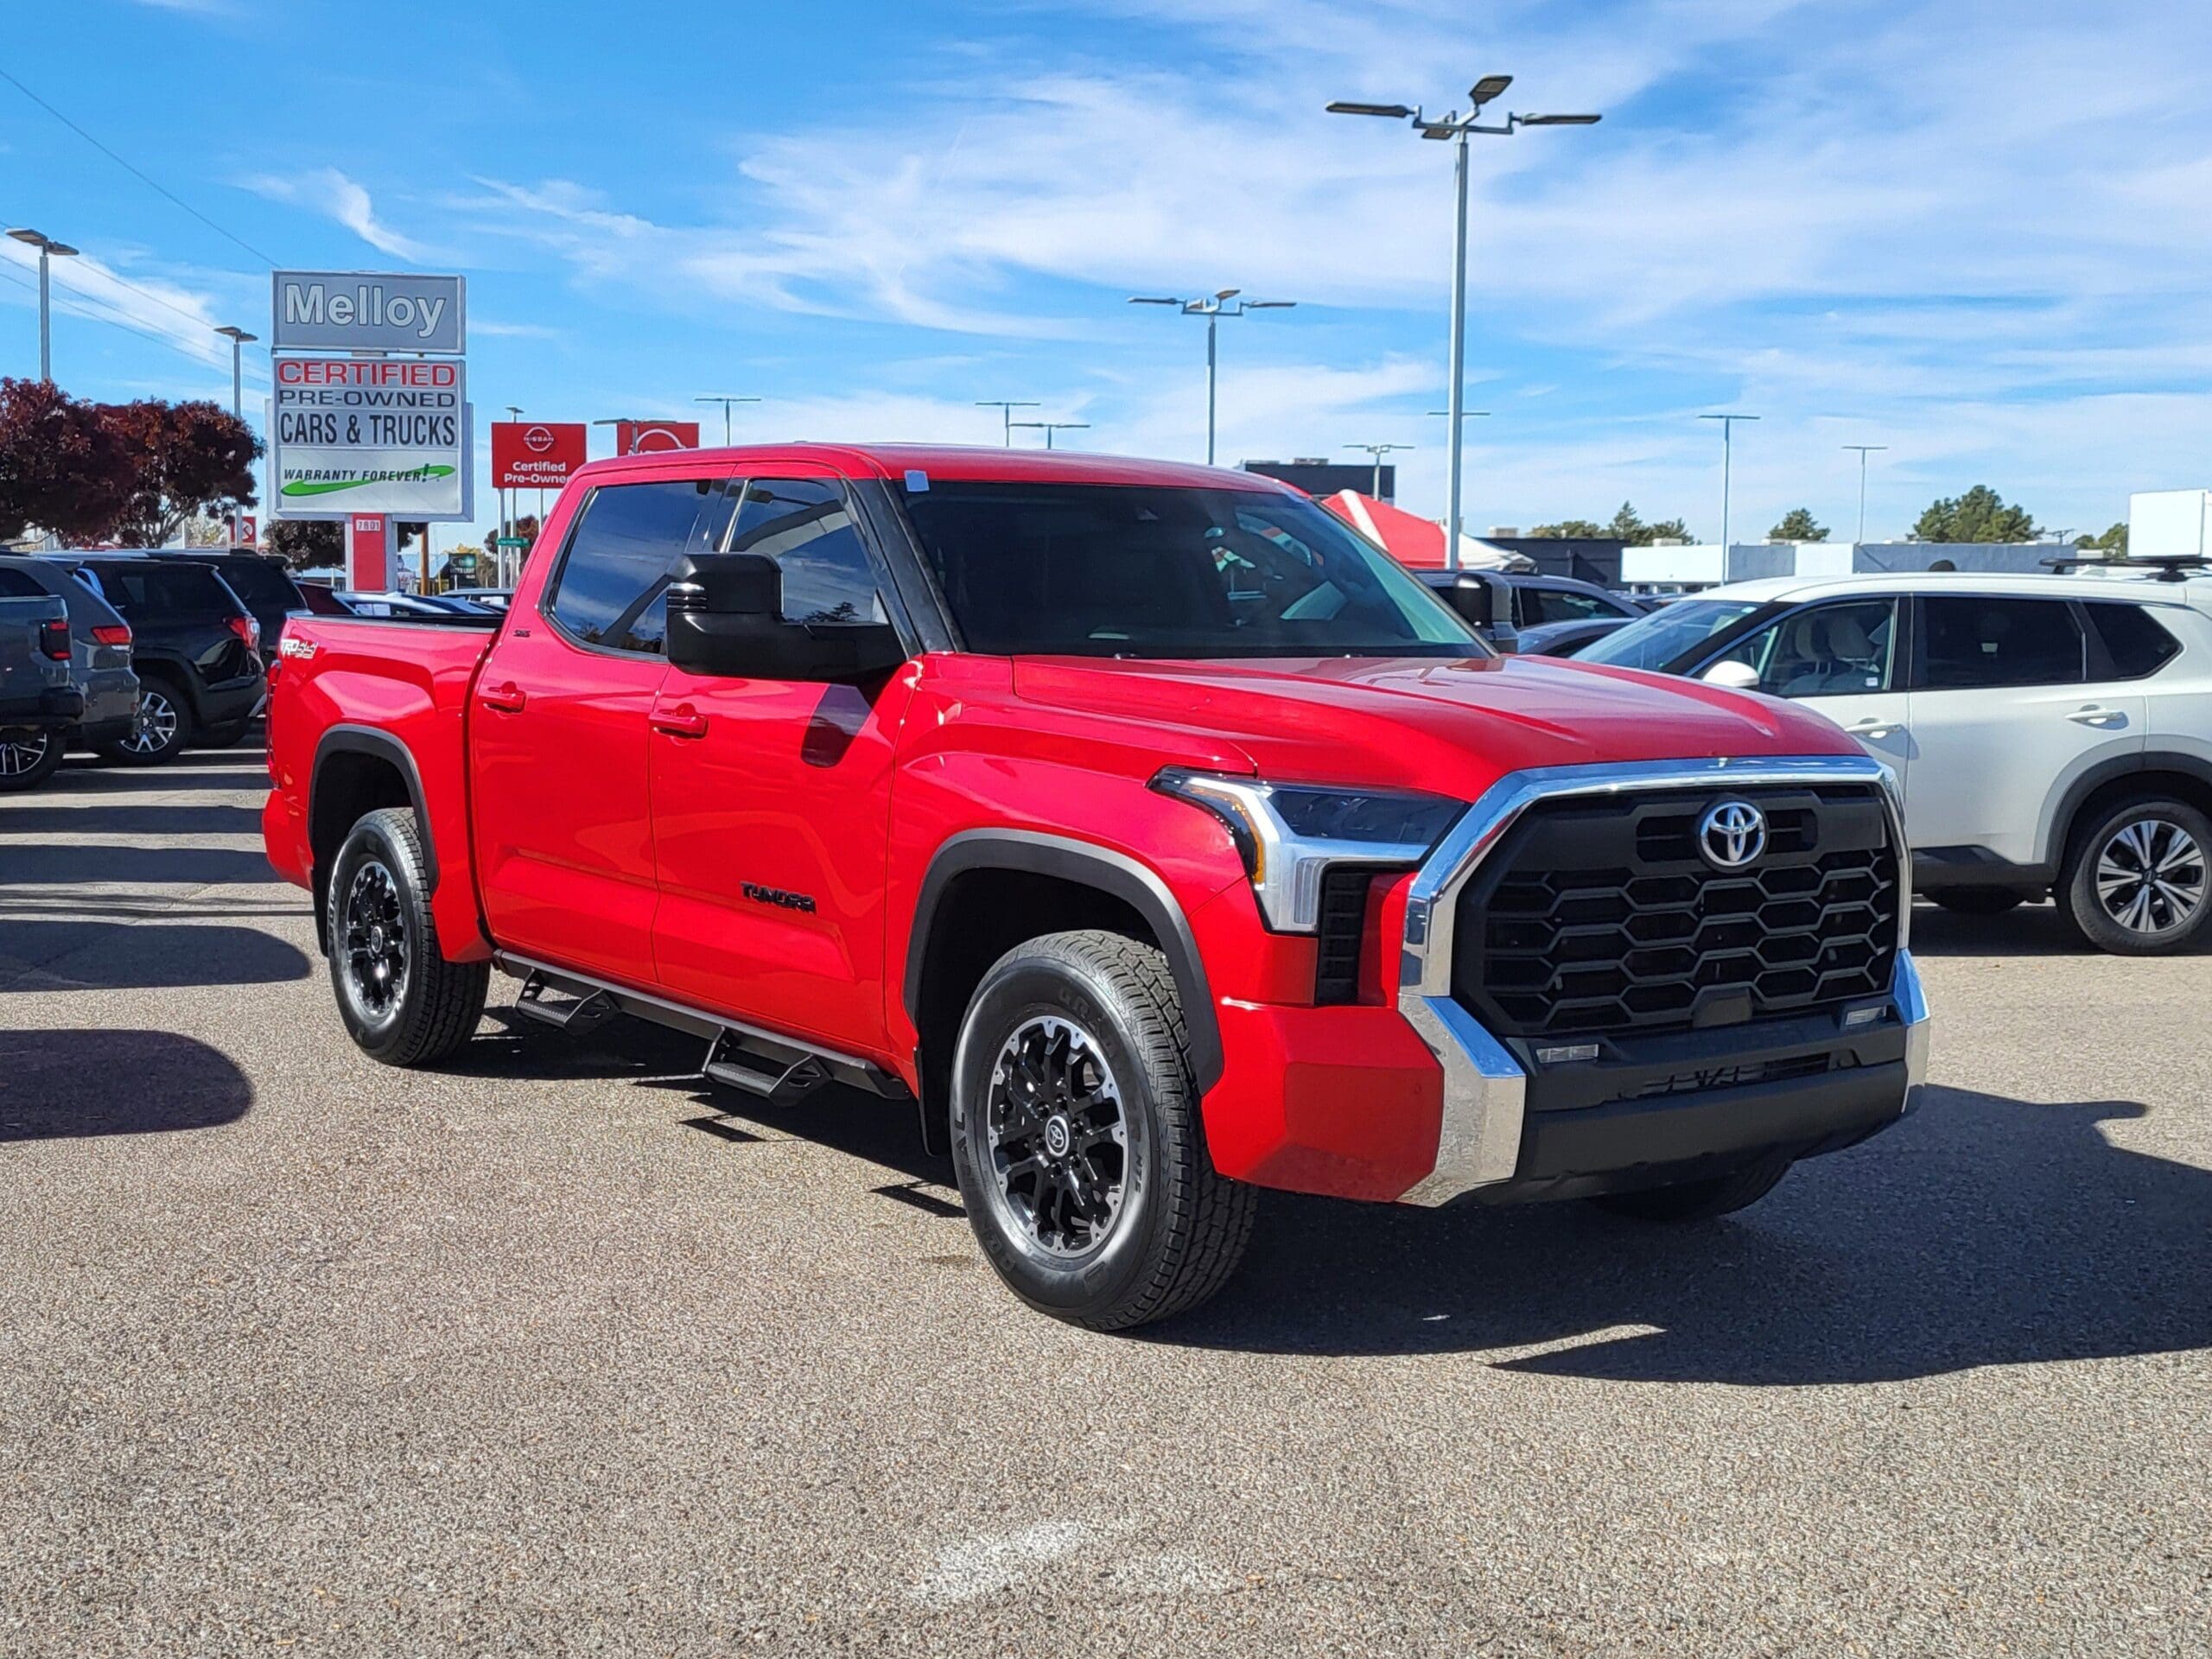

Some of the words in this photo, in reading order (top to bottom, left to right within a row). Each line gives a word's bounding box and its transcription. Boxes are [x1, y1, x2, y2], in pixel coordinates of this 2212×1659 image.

[284, 283, 446, 338] Melloy
[278, 361, 456, 386] CERTIFIED
[279, 391, 455, 408] PRE-OWNED
[280, 412, 337, 444] CARS
[346, 414, 361, 444] &
[370, 415, 455, 446] TRUCKS
[283, 468, 356, 481] WARRANTY
[361, 463, 429, 483] FOREVER!
[512, 461, 566, 472] Certified
[358, 520, 379, 530] 7801
[741, 881, 817, 915] TUNDRA
